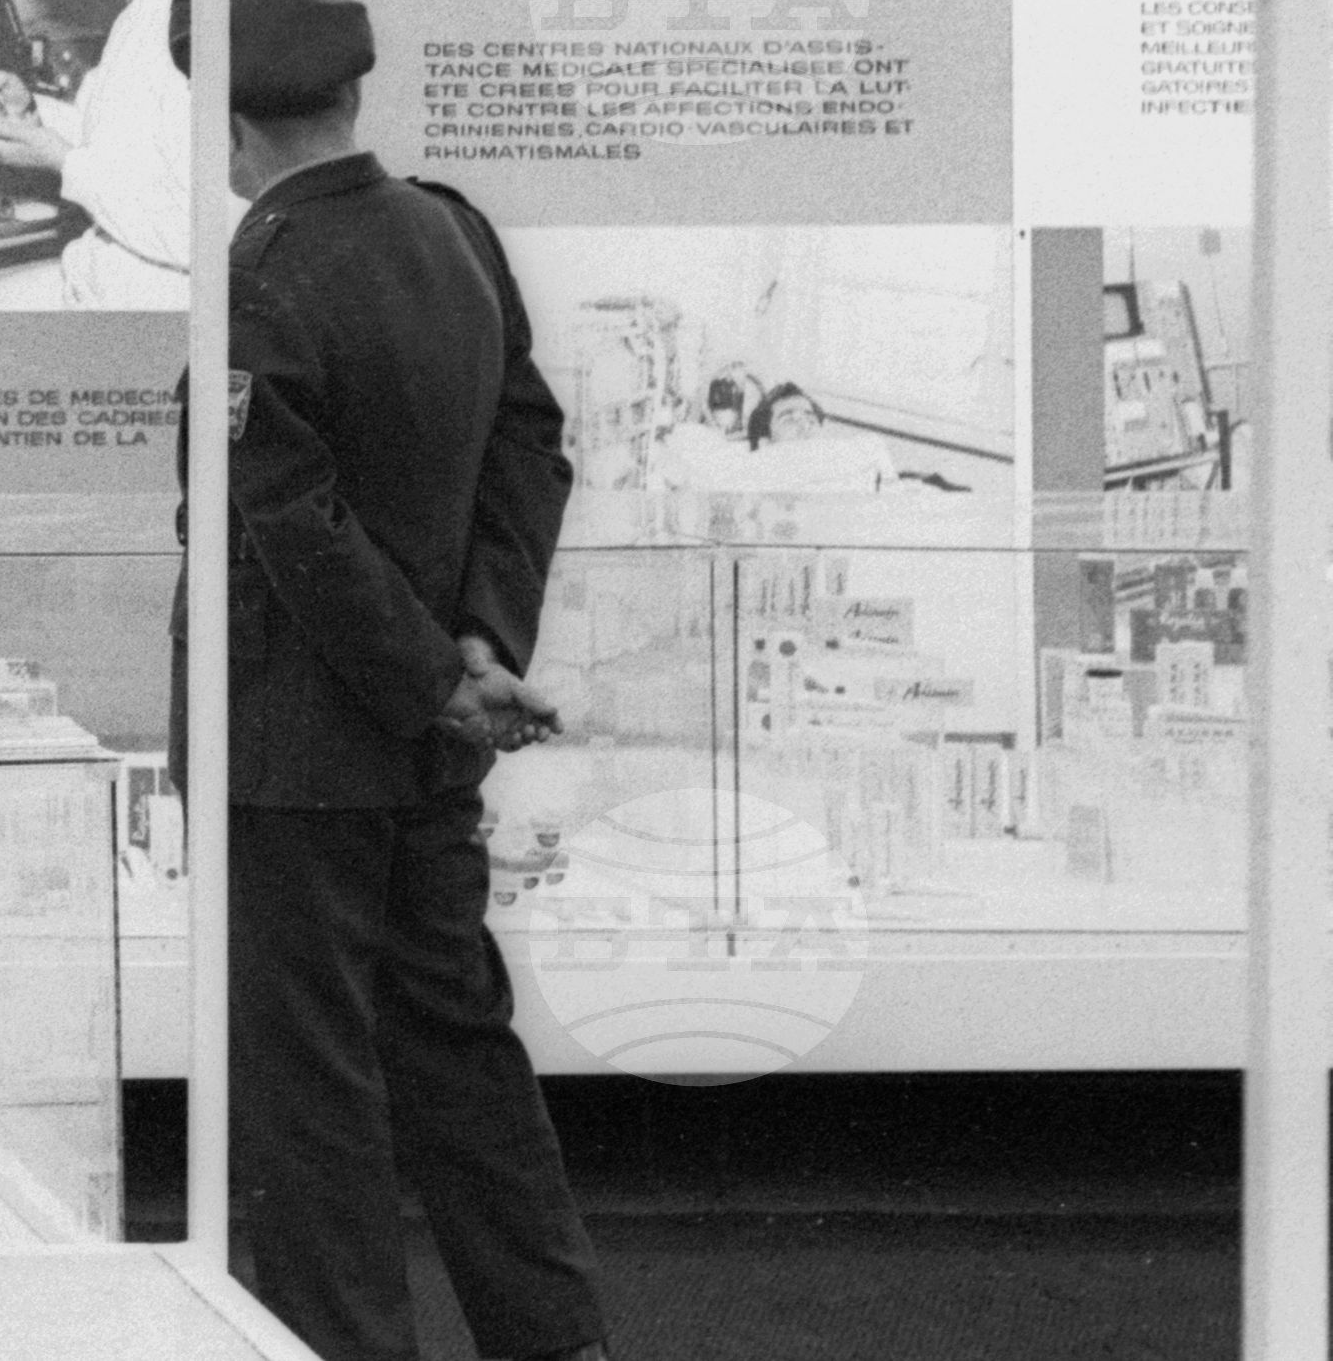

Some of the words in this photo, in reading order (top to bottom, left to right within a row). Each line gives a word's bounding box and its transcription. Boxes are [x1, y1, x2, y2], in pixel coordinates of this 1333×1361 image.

[423, 42, 474, 58] DES
[482, 42, 604, 58] CENTRES
[614, 41, 753, 57] NATIONAUX
[425, 62, 511, 79] TANCE
[522, 61, 657, 78] MEDICALE
[666, 60, 845, 76] SPECIALISEE
[854, 58, 910, 75] ONT
[423, 82, 469, 98] ETE
[479, 82, 576, 98] CREES
[586, 81, 659, 98] POUR
[669, 80, 804, 97] FACILITER
[814, 80, 849, 96] LA
[425, 102, 457, 117] TE
[466, 102, 578, 118] CONTRE
[587, 101, 637, 117] LES
[643, 100, 813, 116] AFFECTIONS
[884, 118, 915, 135] ET
[423, 143, 642, 160] RHUMATISMALES
[28, 389, 61, 406] DE
[17, 410, 66, 426] DES
[77, 410, 180, 426] CADRES
[74, 430, 107, 446] DE
[116, 430, 148, 446] LA
